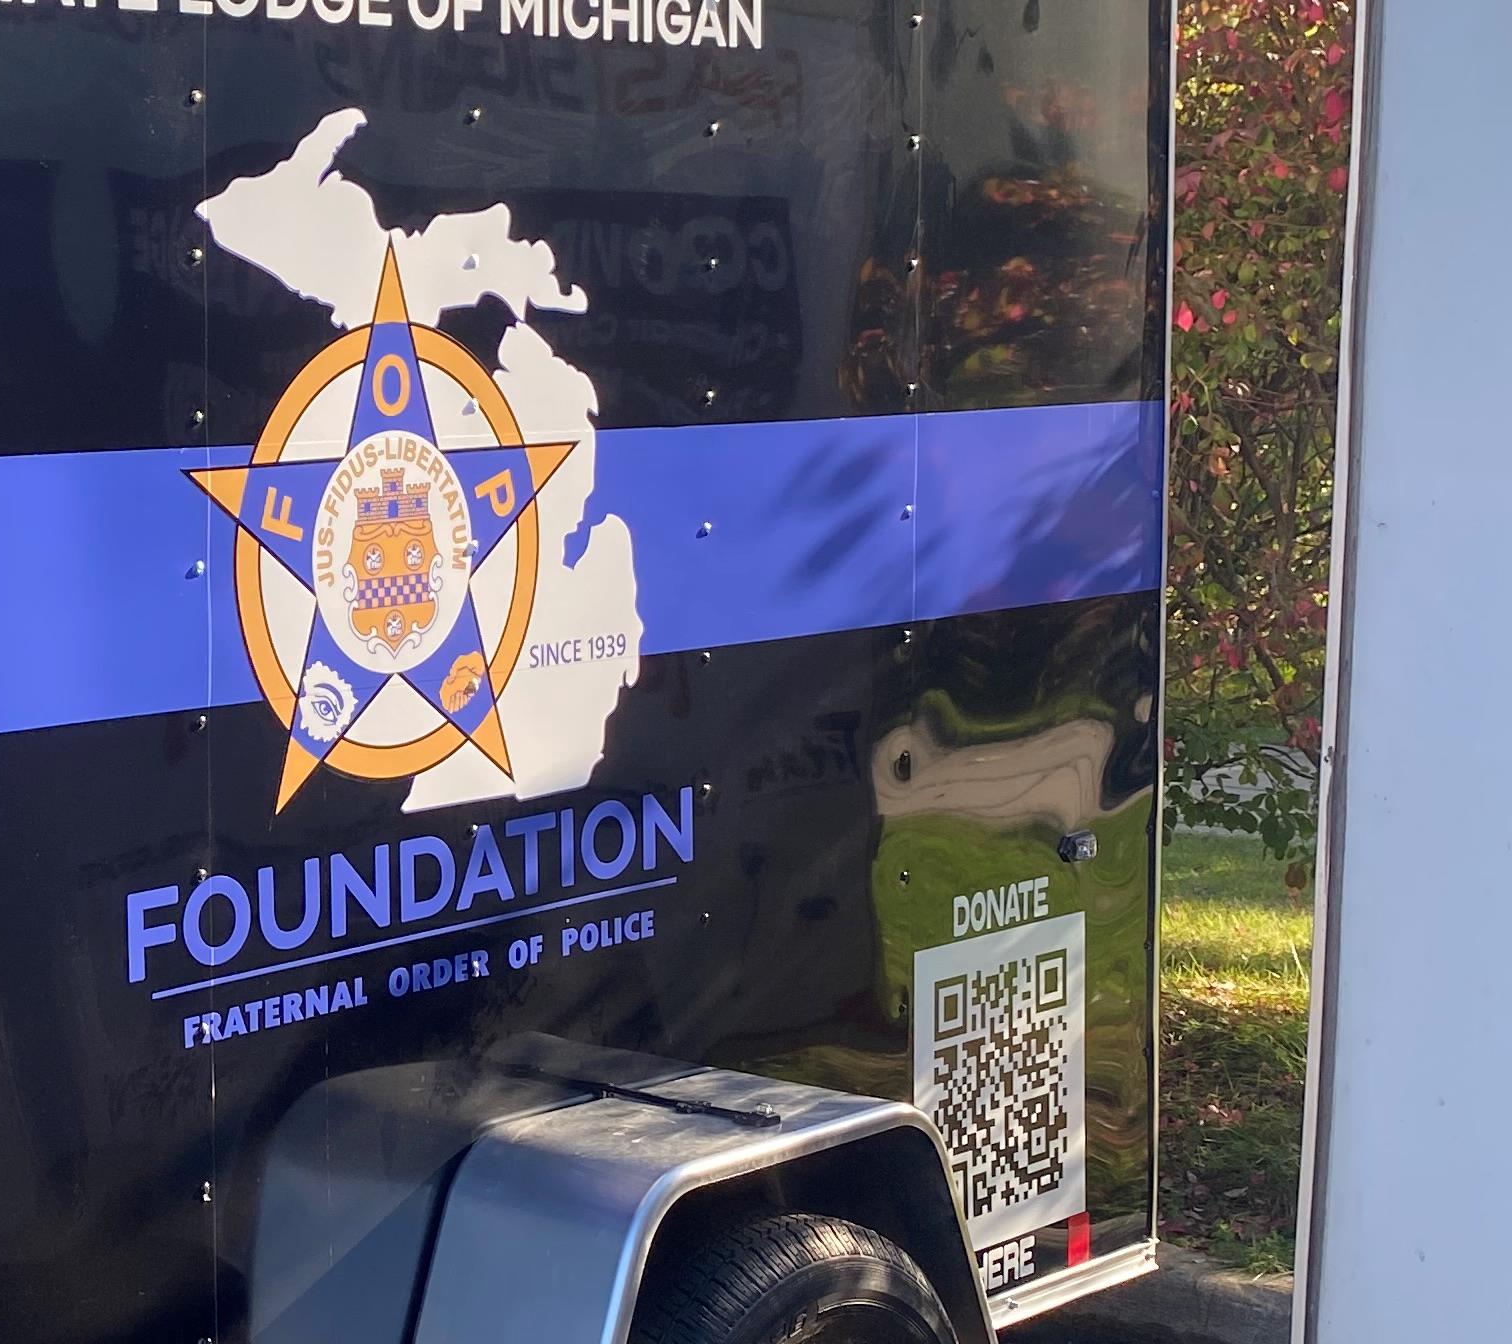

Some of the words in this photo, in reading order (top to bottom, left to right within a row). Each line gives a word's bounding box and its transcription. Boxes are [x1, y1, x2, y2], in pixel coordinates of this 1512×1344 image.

[372, 354, 411, 417] O
[529, 639, 582, 668] SINCE
[587, 633, 627, 660] 1939
[126, 786, 695, 984] FOUNDATION
[953, 876, 1049, 938] DONATE
[183, 976, 368, 1049] FRATERNAL
[388, 949, 491, 997] ORDER
[508, 934, 544, 970] OF
[561, 910, 655, 956] POLICE
